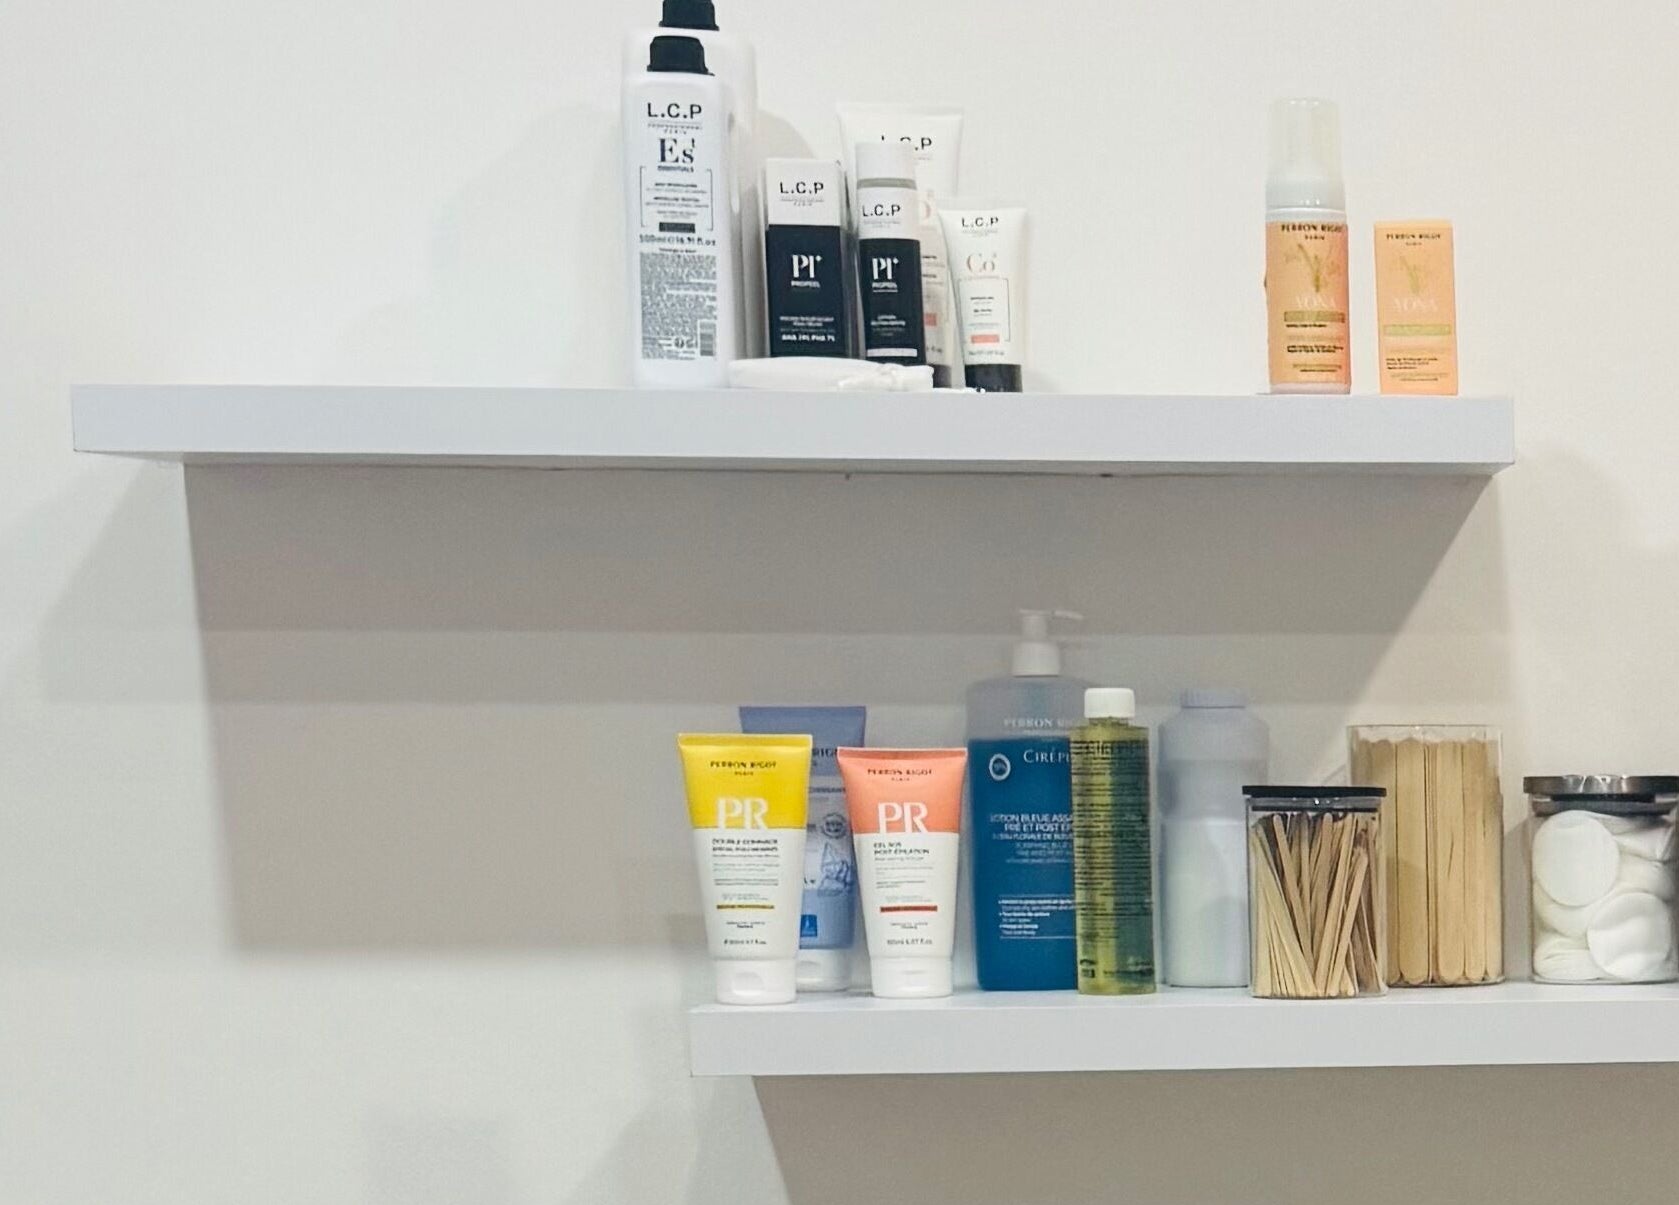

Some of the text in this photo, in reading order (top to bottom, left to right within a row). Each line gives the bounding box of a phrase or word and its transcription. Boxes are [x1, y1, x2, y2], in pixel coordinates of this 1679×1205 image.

[647, 102, 702, 119] L.C.P
[780, 182, 824, 194] L.C.P
[862, 204, 901, 217] L.C.P
[961, 217, 999, 228] L.C.P
[716, 797, 769, 830] PR
[878, 802, 929, 834] PR
